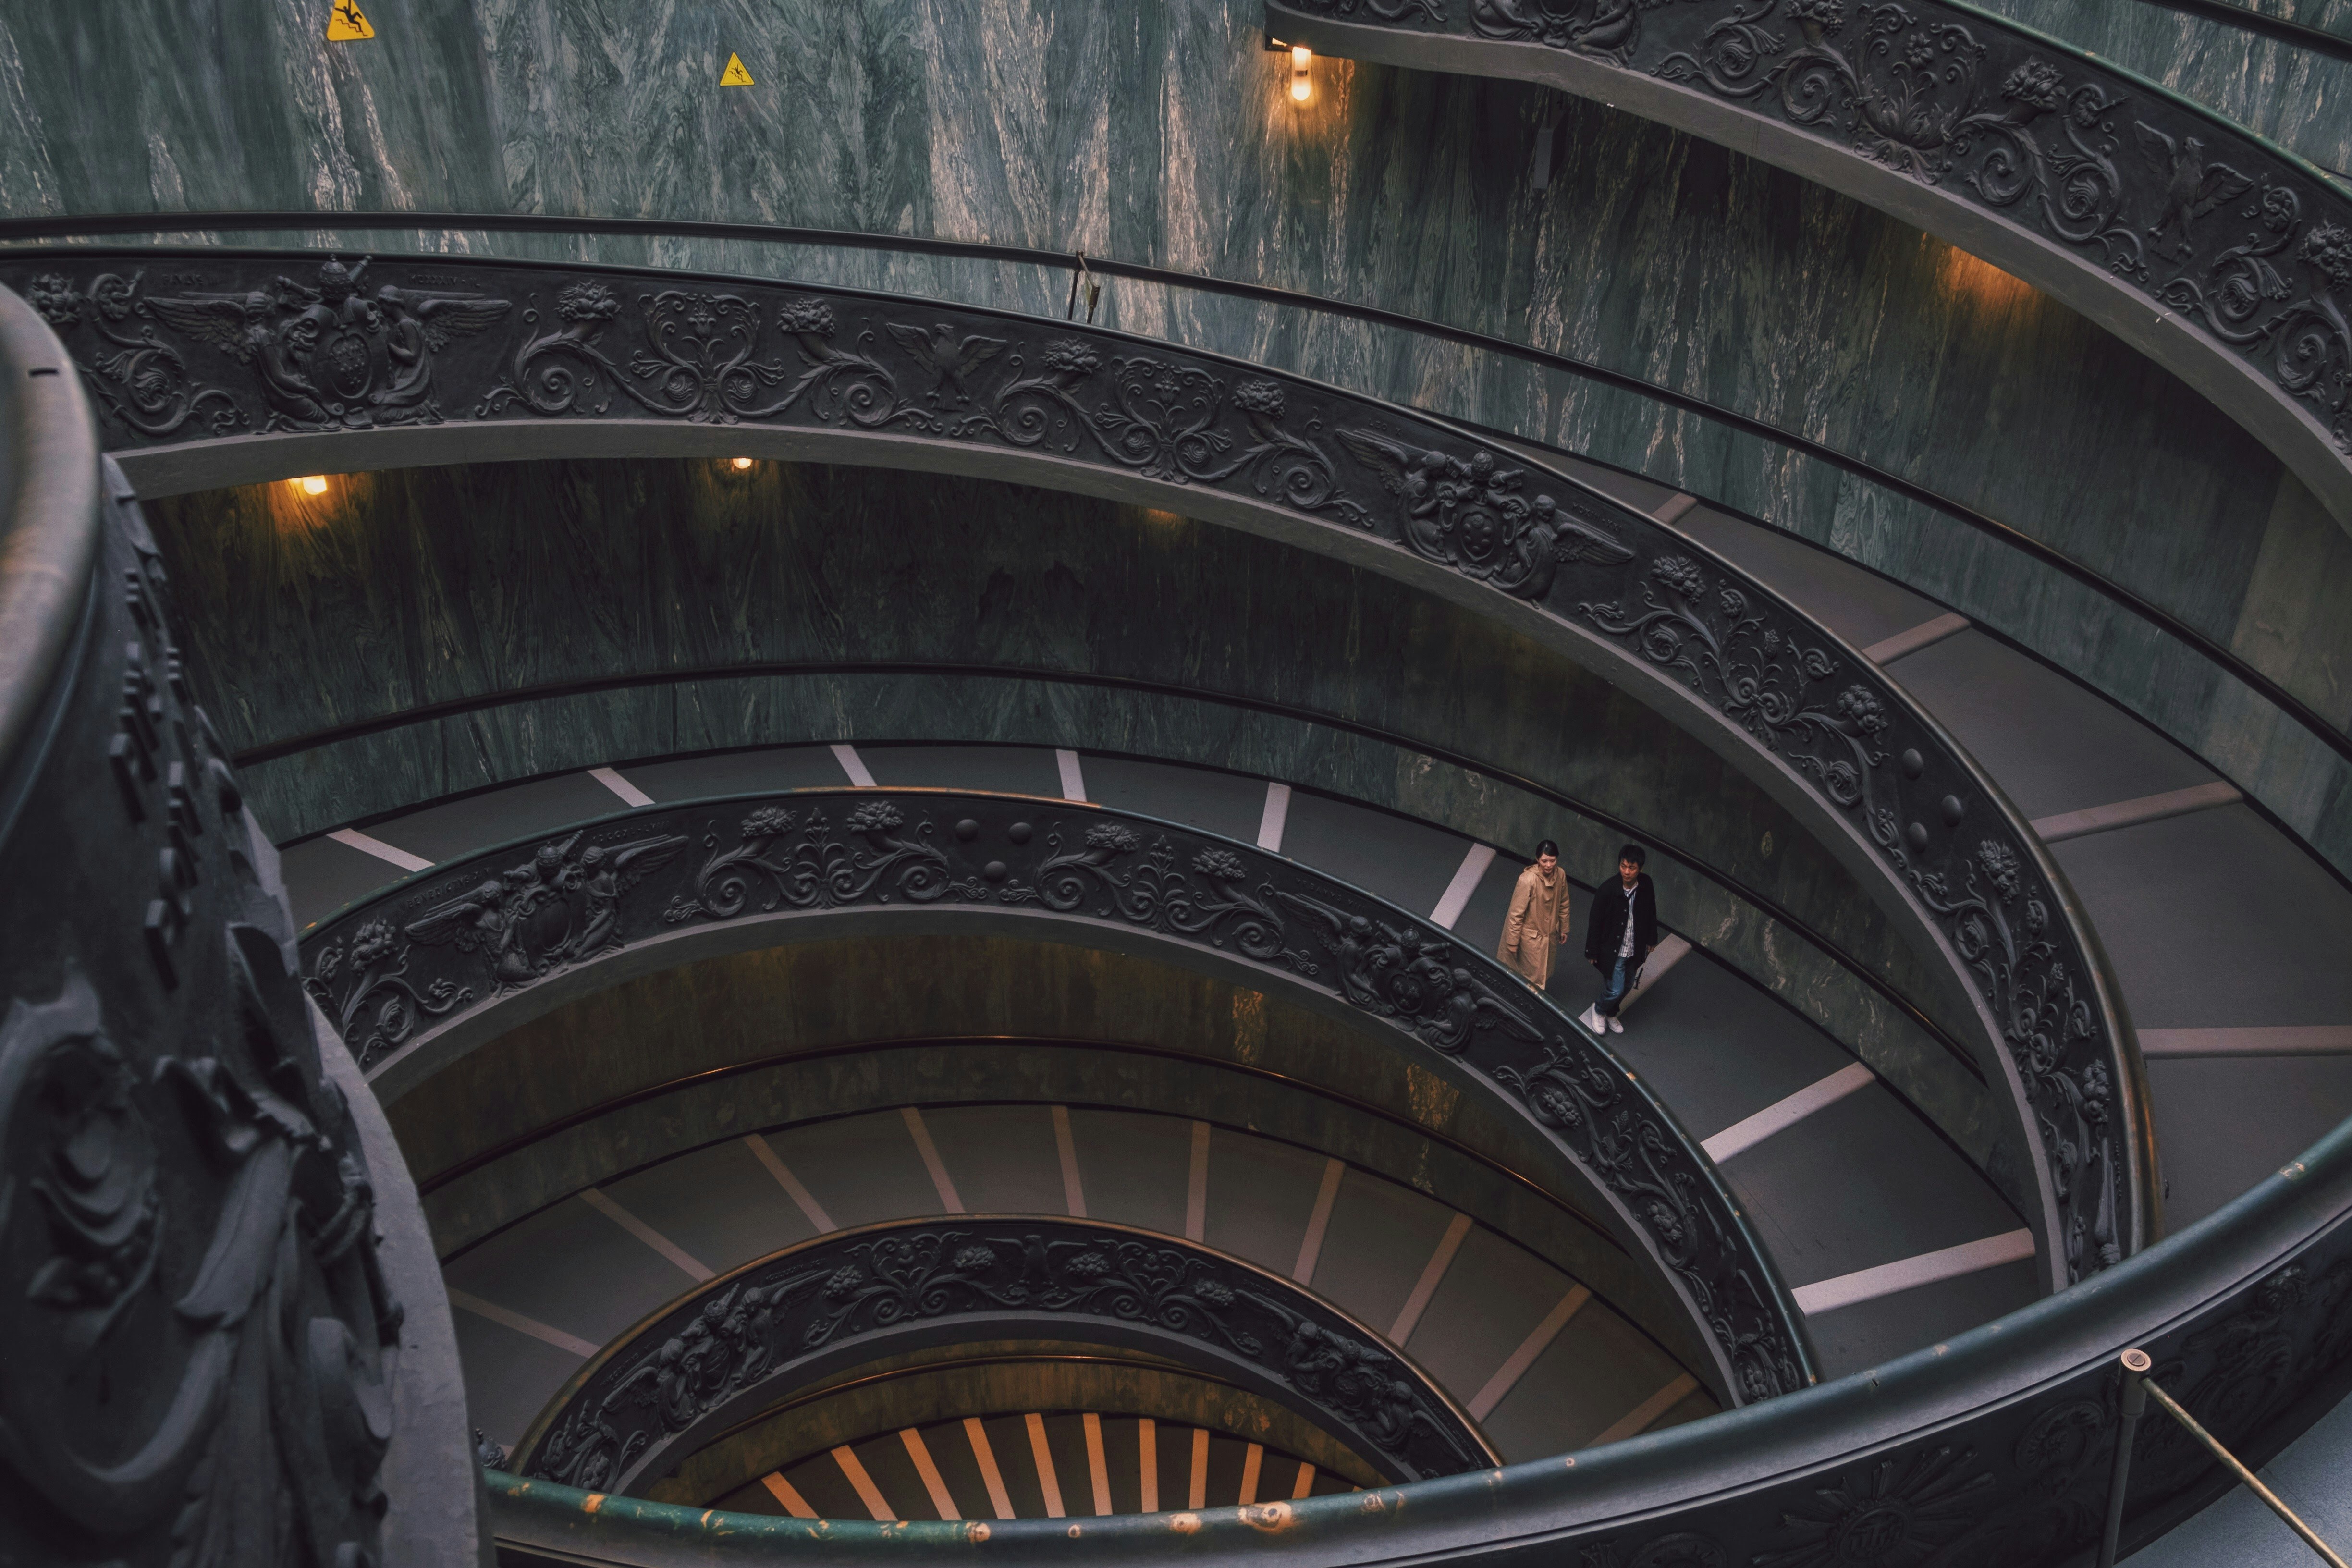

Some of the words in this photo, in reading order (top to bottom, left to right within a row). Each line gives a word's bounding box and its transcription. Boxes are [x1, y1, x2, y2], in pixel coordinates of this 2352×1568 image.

[1368, 417, 1388, 431] LEO
[1396, 427, 1402, 438] X
[406, 874, 470, 908] BENEDICTVS
[1296, 877, 1342, 904] VRBANVS
